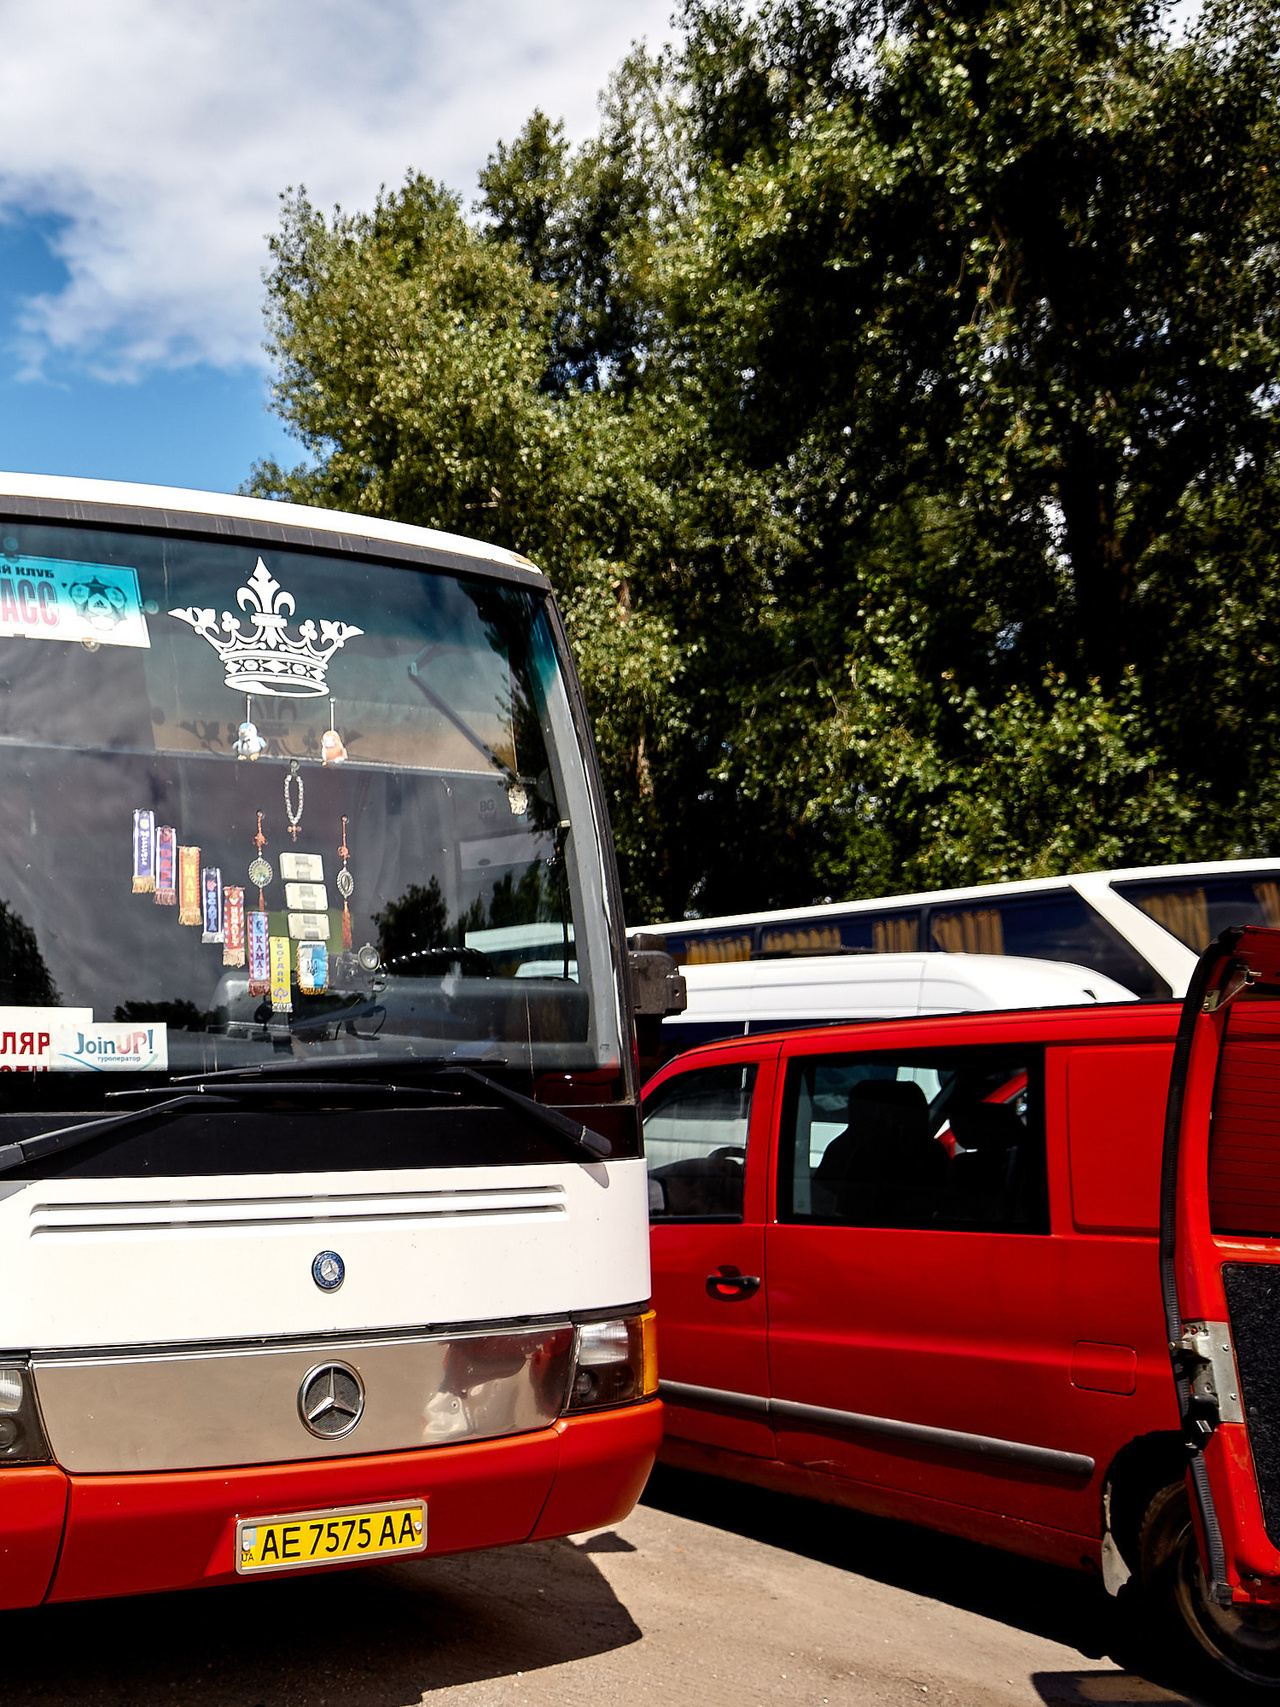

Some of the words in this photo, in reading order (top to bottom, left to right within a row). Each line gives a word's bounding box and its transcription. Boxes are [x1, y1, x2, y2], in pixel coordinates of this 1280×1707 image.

[16, 566, 55, 578] КЛУБ
[184, 864, 195, 902] MAN
[255, 935, 264, 977] КАМАЗ
[261, 1526, 301, 1561] AE
[309, 1518, 371, 1555] 7575
[379, 1513, 415, 1547] AA
